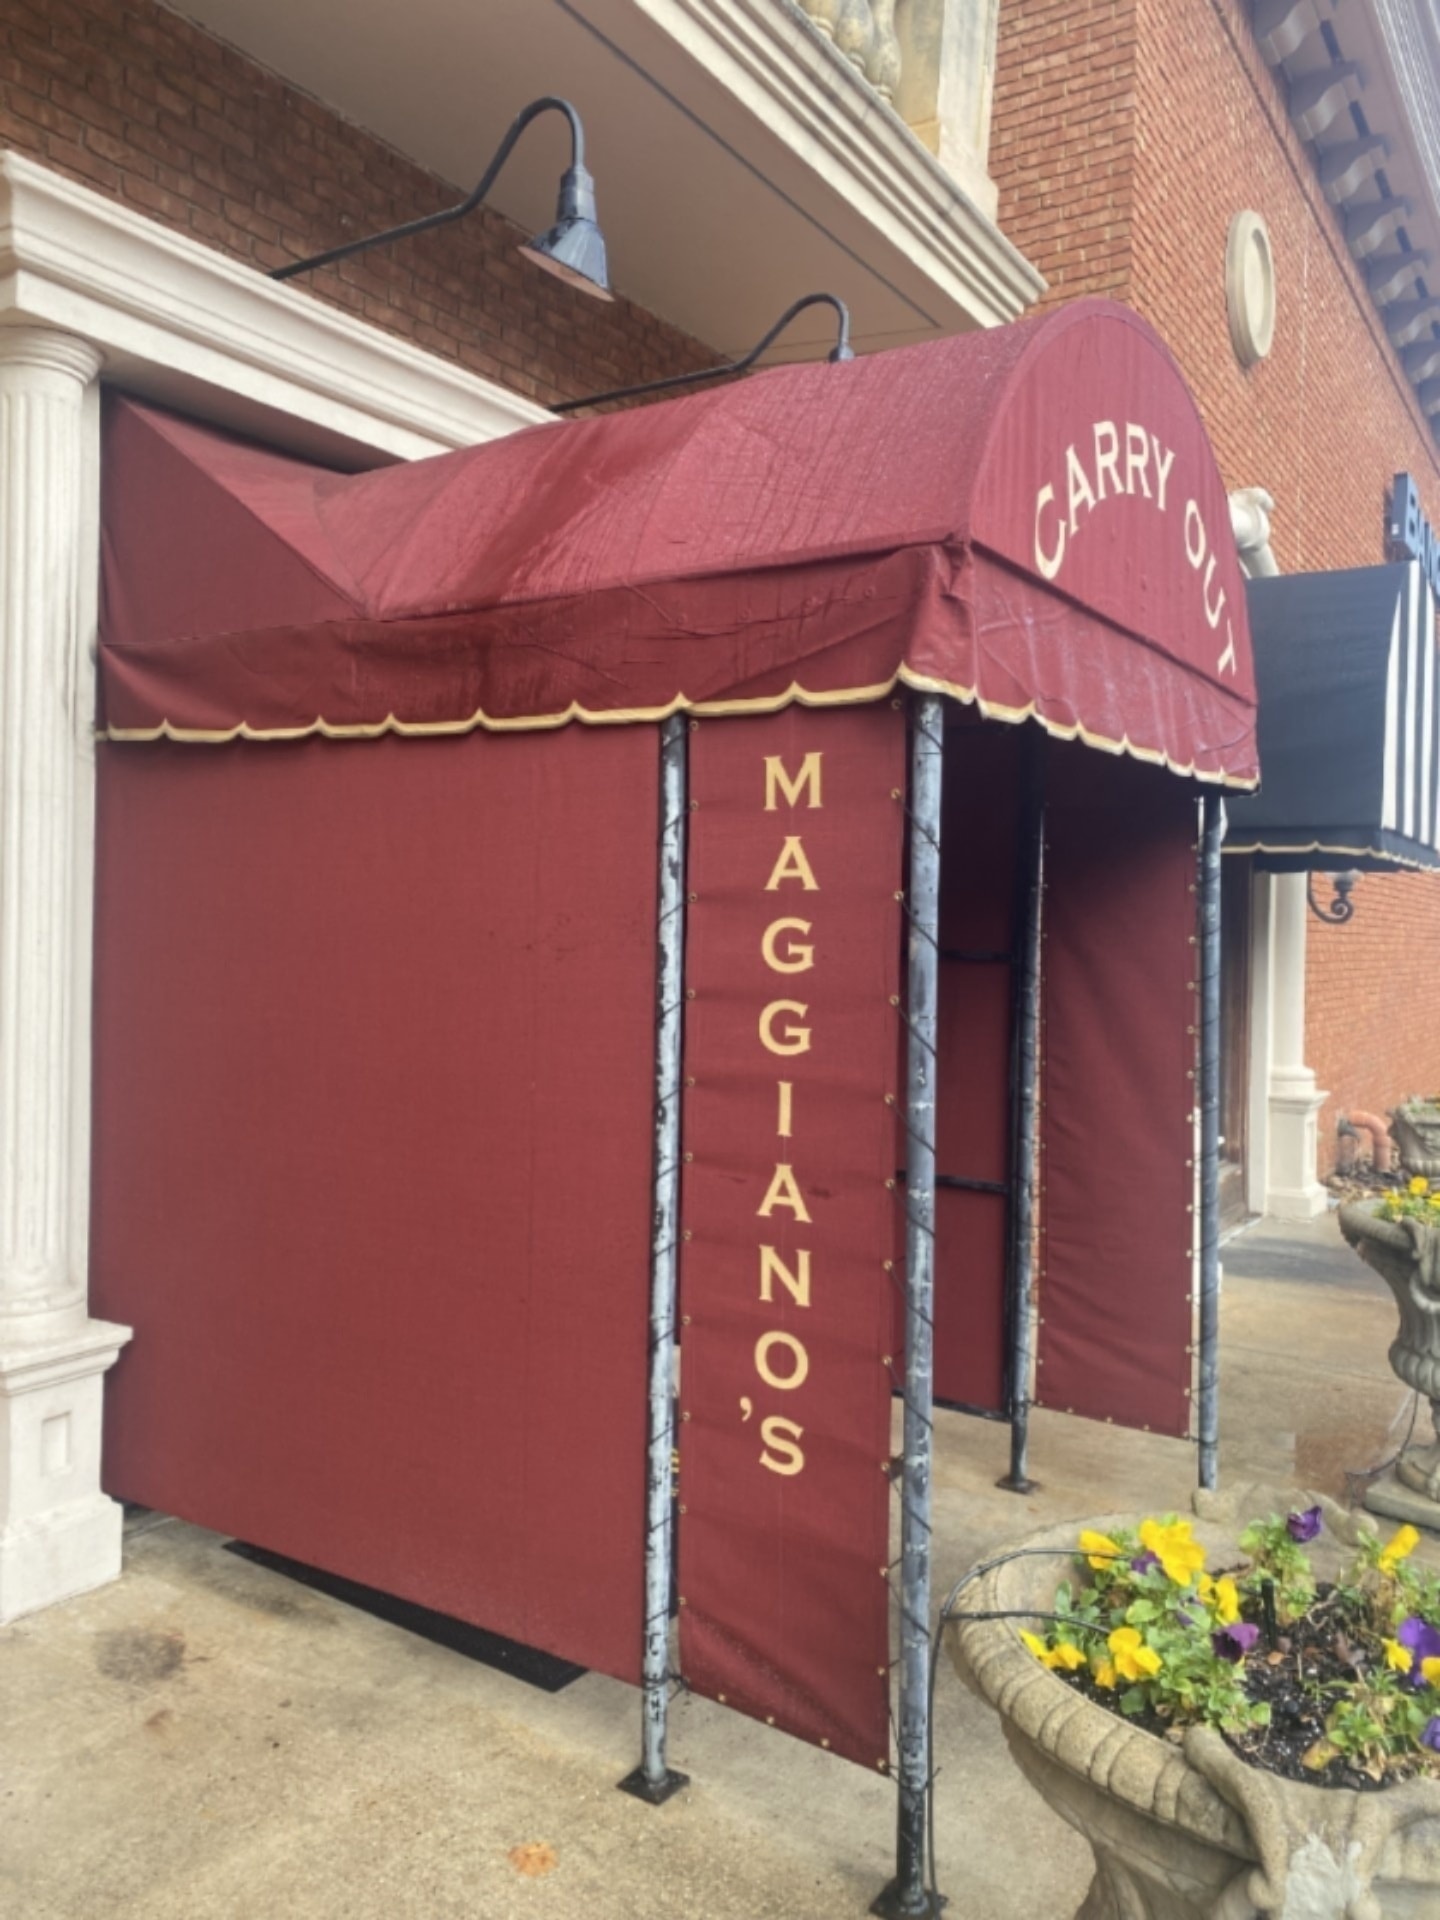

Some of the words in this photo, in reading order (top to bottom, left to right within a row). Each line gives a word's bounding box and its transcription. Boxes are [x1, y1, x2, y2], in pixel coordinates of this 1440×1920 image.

[1034, 420, 1176, 580] CARRY
[1184, 499, 1238, 676] OUT
[739, 751, 823, 1476] MAGGIANO'S
